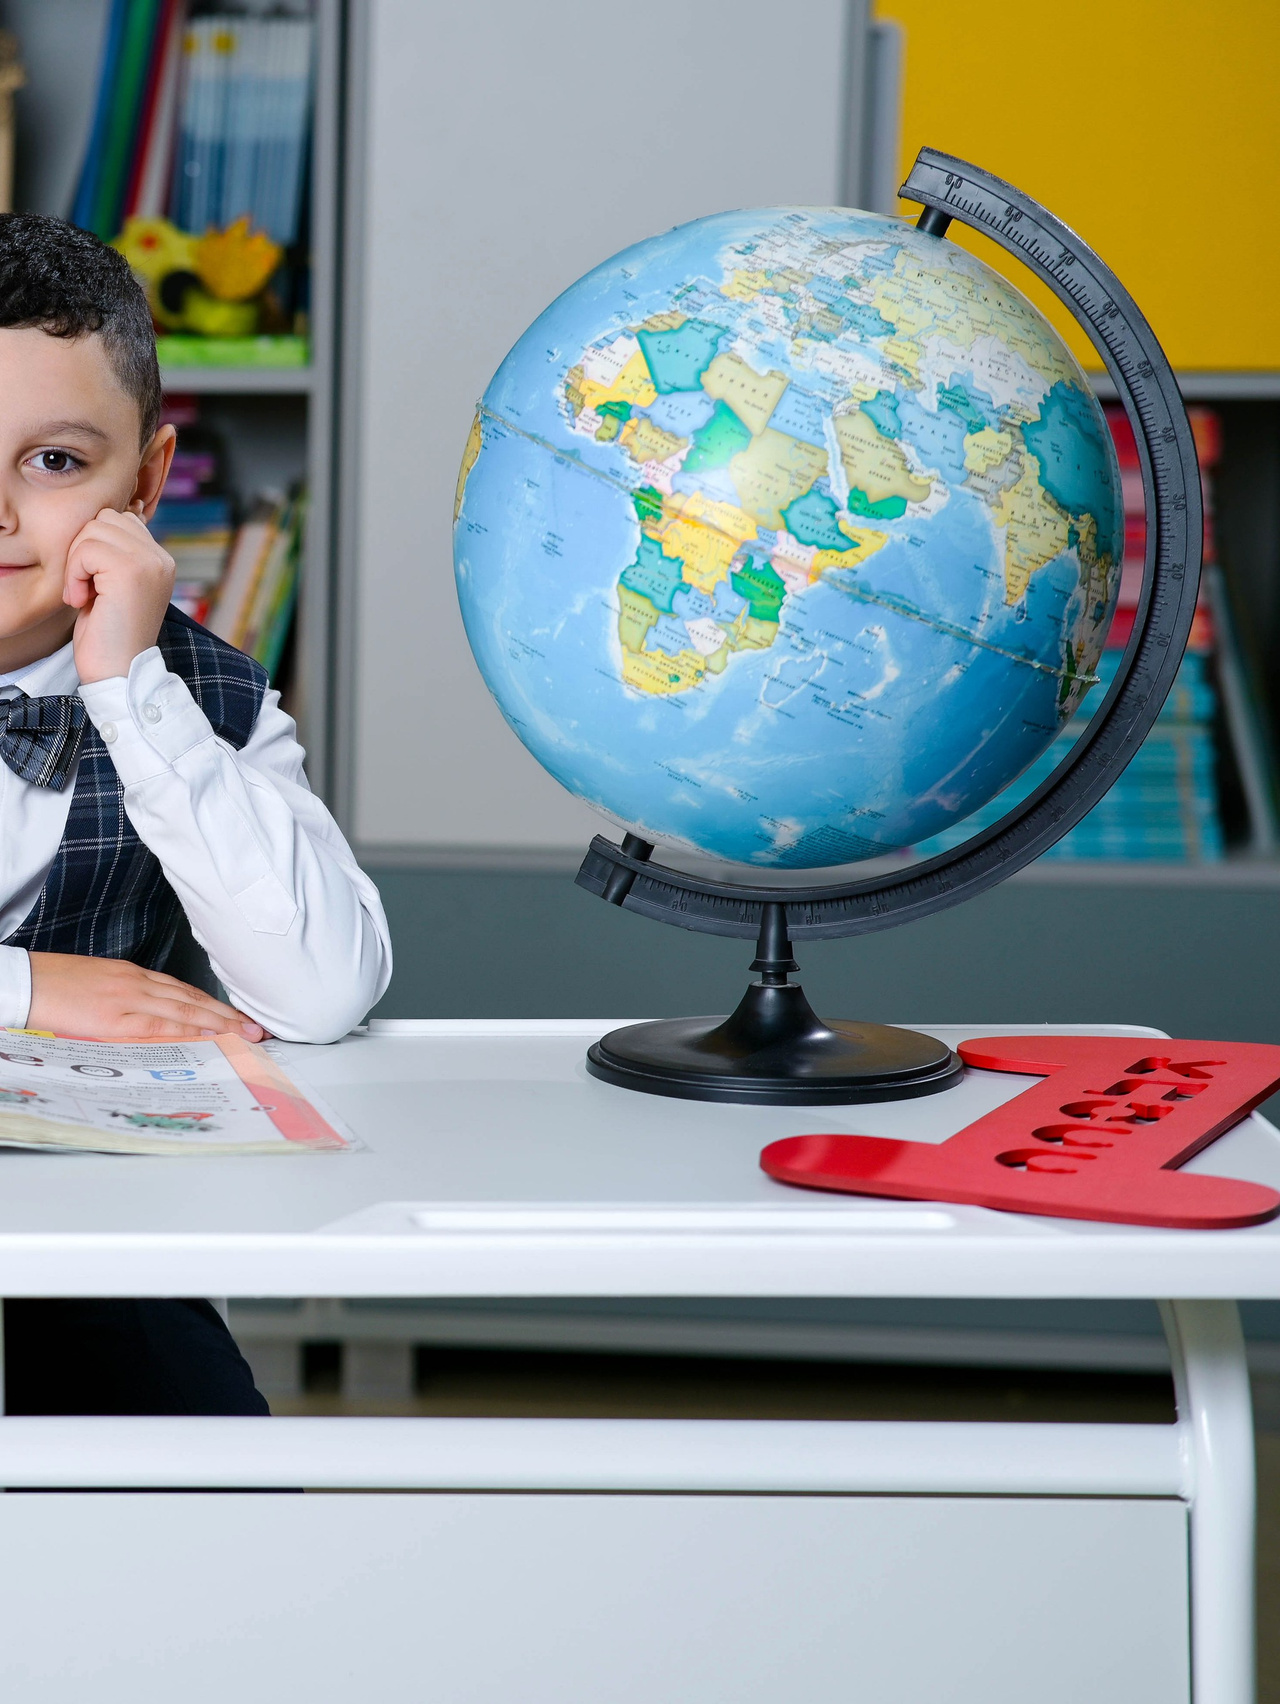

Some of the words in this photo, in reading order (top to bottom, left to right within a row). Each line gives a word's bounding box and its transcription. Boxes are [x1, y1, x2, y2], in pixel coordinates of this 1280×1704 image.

[943, 172, 966, 190] 90
[1056, 246, 1078, 268] 70
[1135, 357, 1156, 381] 50
[1158, 424, 1176, 446] 40
[1170, 491, 1187, 514] 30
[1167, 559, 1186, 583] 20
[1156, 629, 1175, 651] 10
